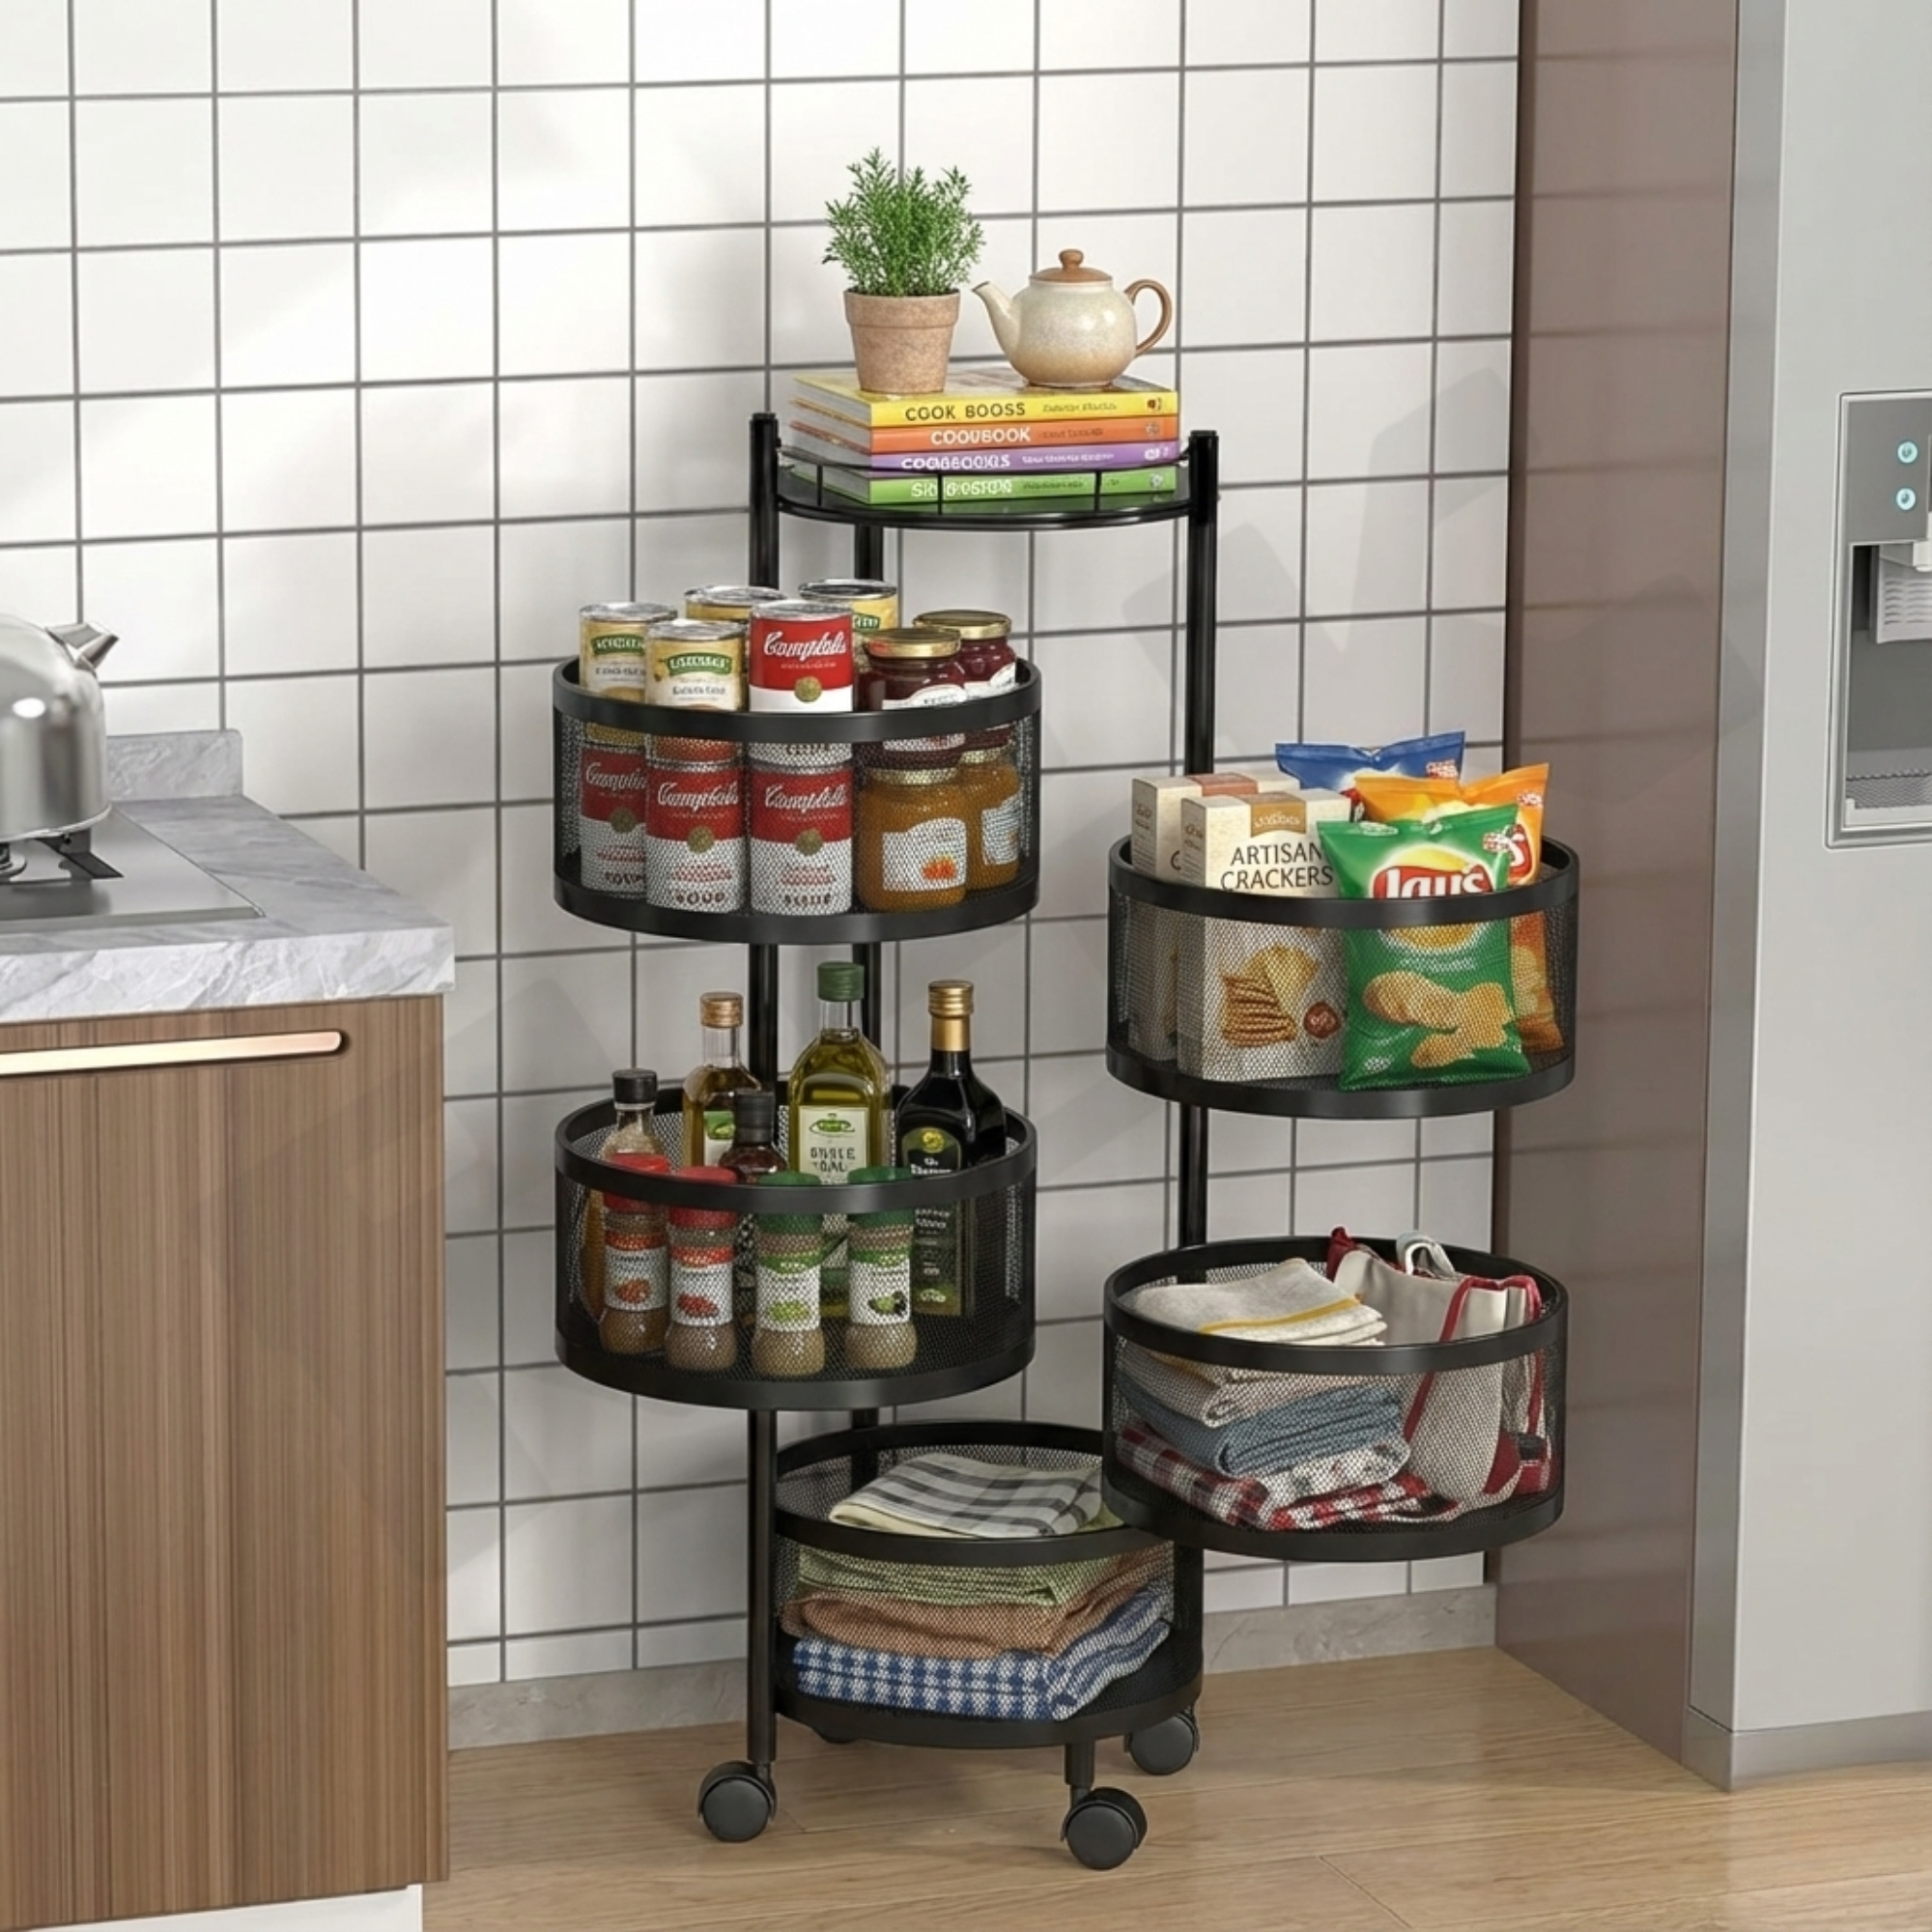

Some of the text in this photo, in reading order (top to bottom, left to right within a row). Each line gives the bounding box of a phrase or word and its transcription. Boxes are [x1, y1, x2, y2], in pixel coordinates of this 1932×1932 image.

[905, 405, 955, 421] COOK
[965, 402, 1026, 418] BOOSS
[1230, 841, 1322, 867] ARTISAN
[1221, 866, 1333, 892] CRACKERS
